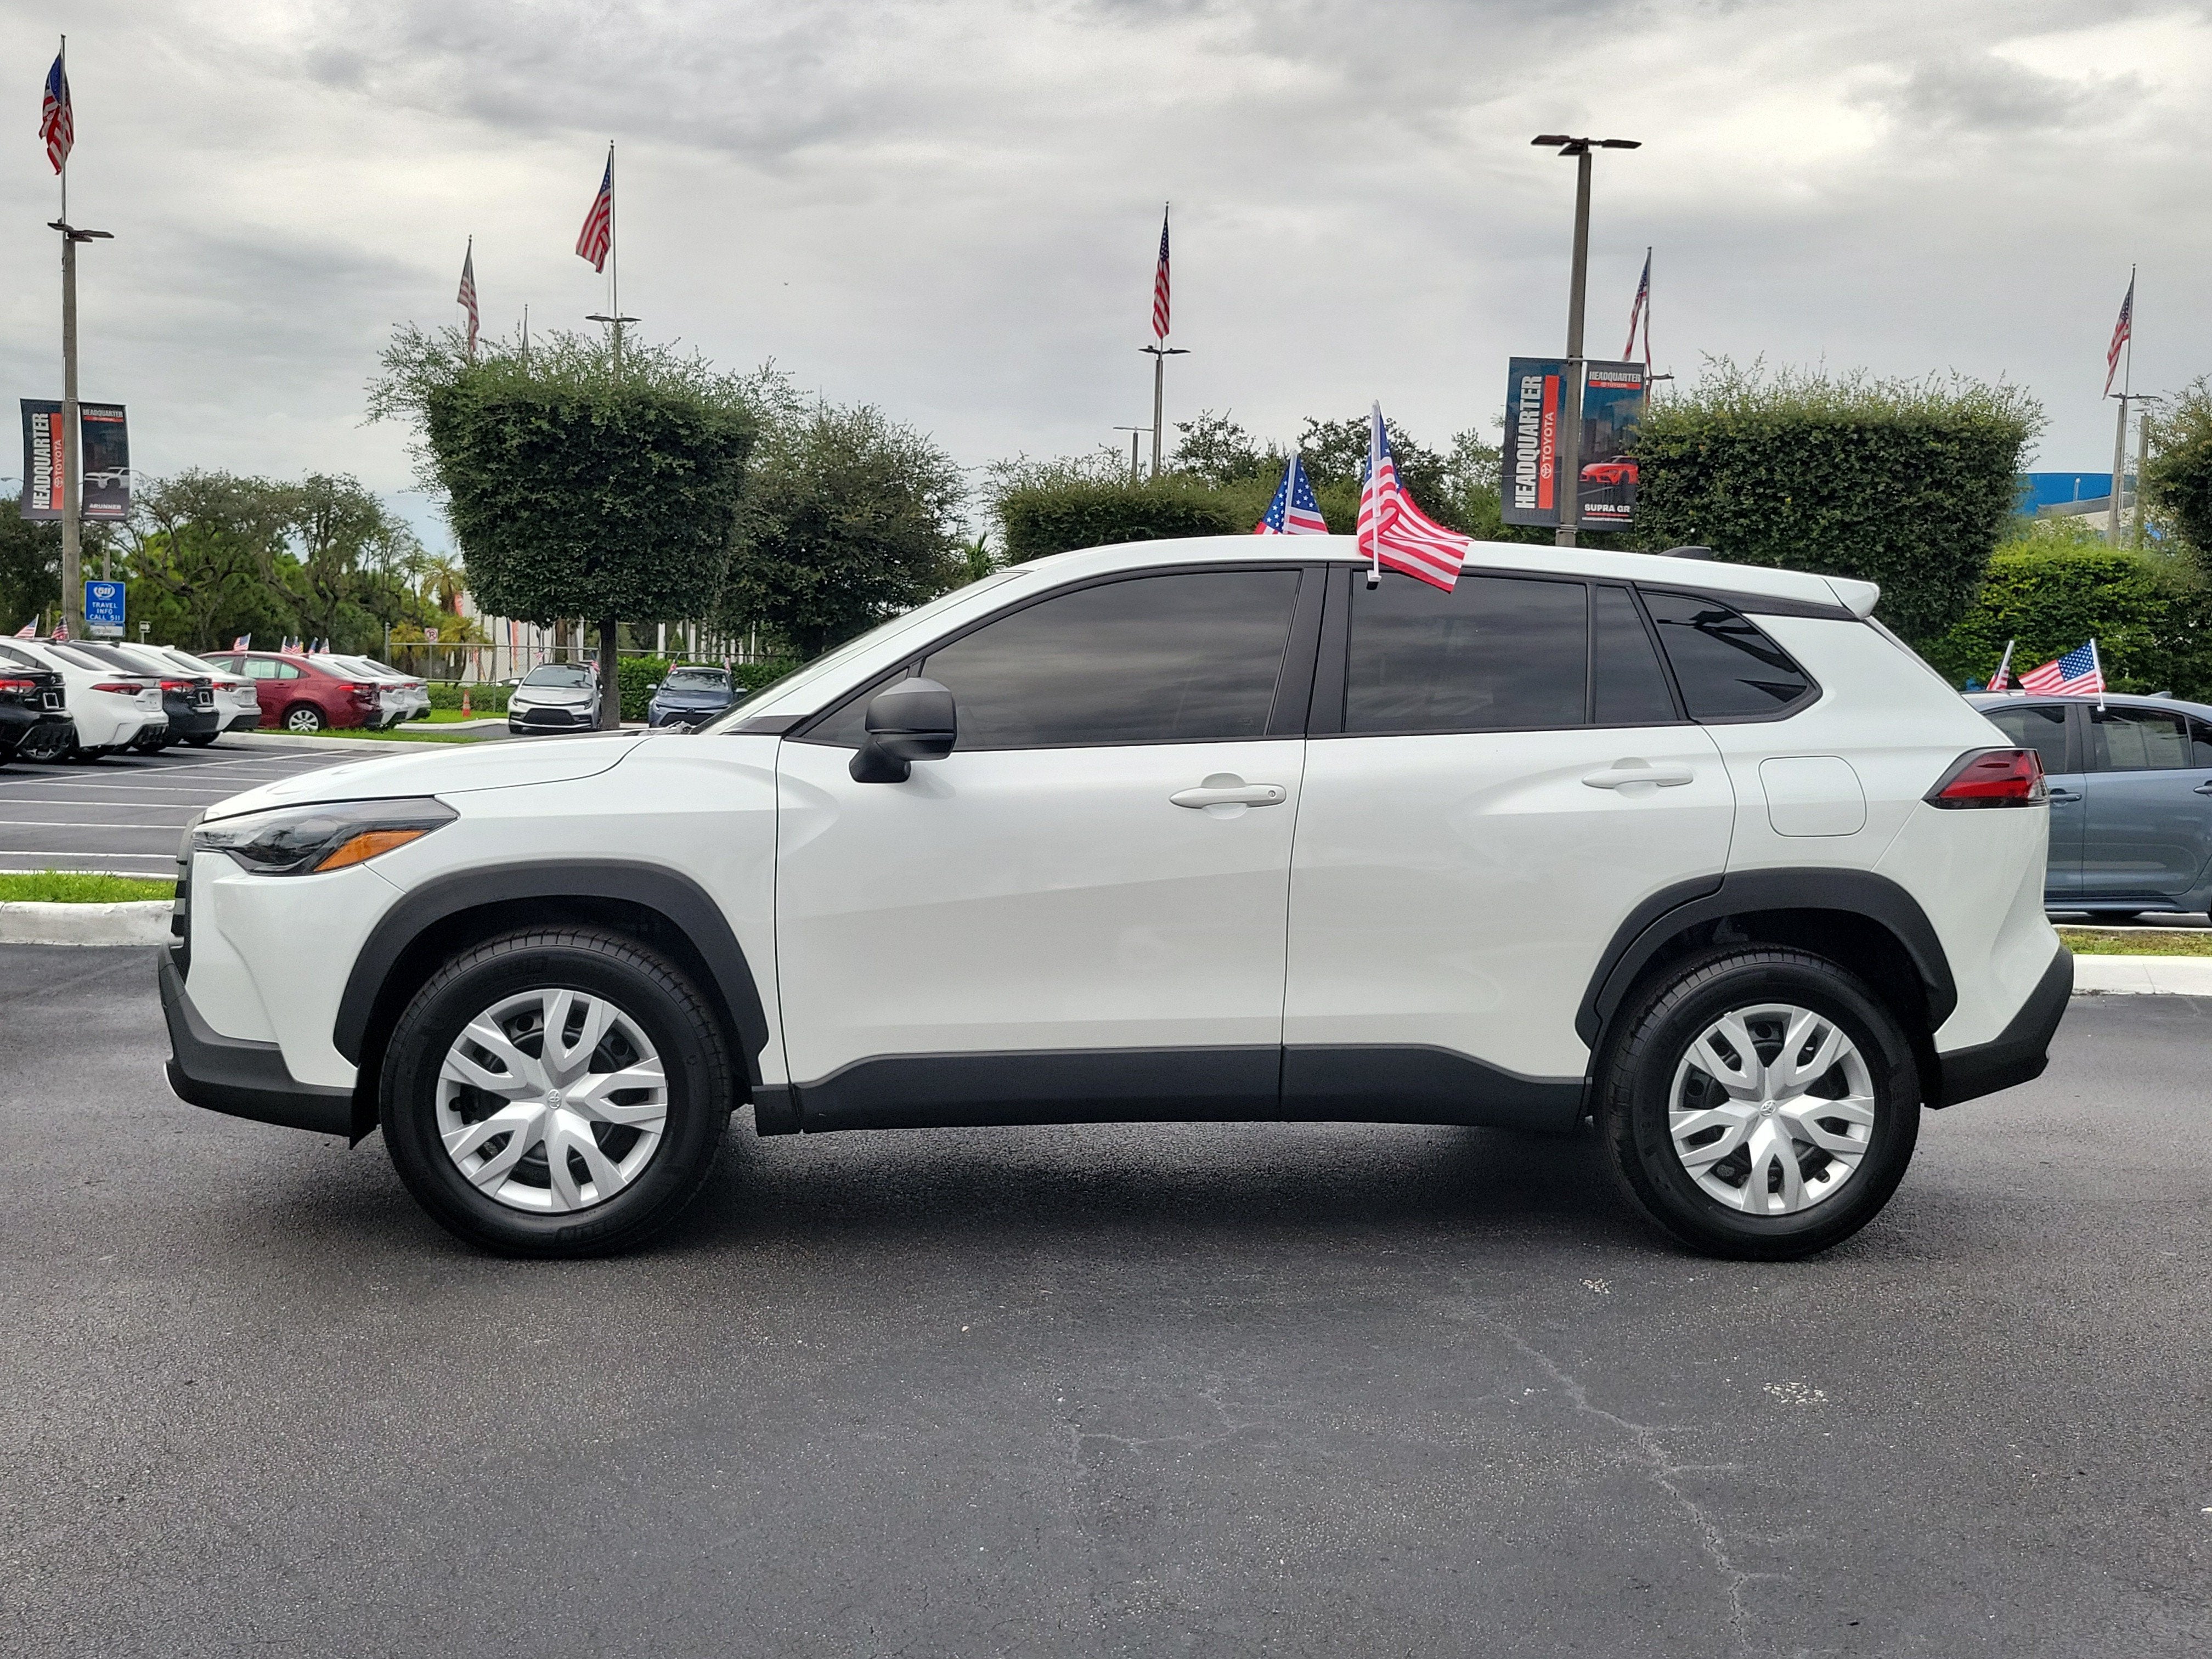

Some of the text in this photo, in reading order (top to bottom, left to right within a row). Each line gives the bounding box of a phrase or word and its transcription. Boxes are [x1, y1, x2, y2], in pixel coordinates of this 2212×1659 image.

[1589, 371, 1641, 382] HEADQUARTER
[54, 439, 63, 477] TOYOTA
[1515, 376, 1542, 509] HEADQUARTER
[1543, 412, 1554, 462] TOYOTA
[32, 413, 53, 509] HEADQUARTER
[1584, 504, 1615, 512] SUPRA
